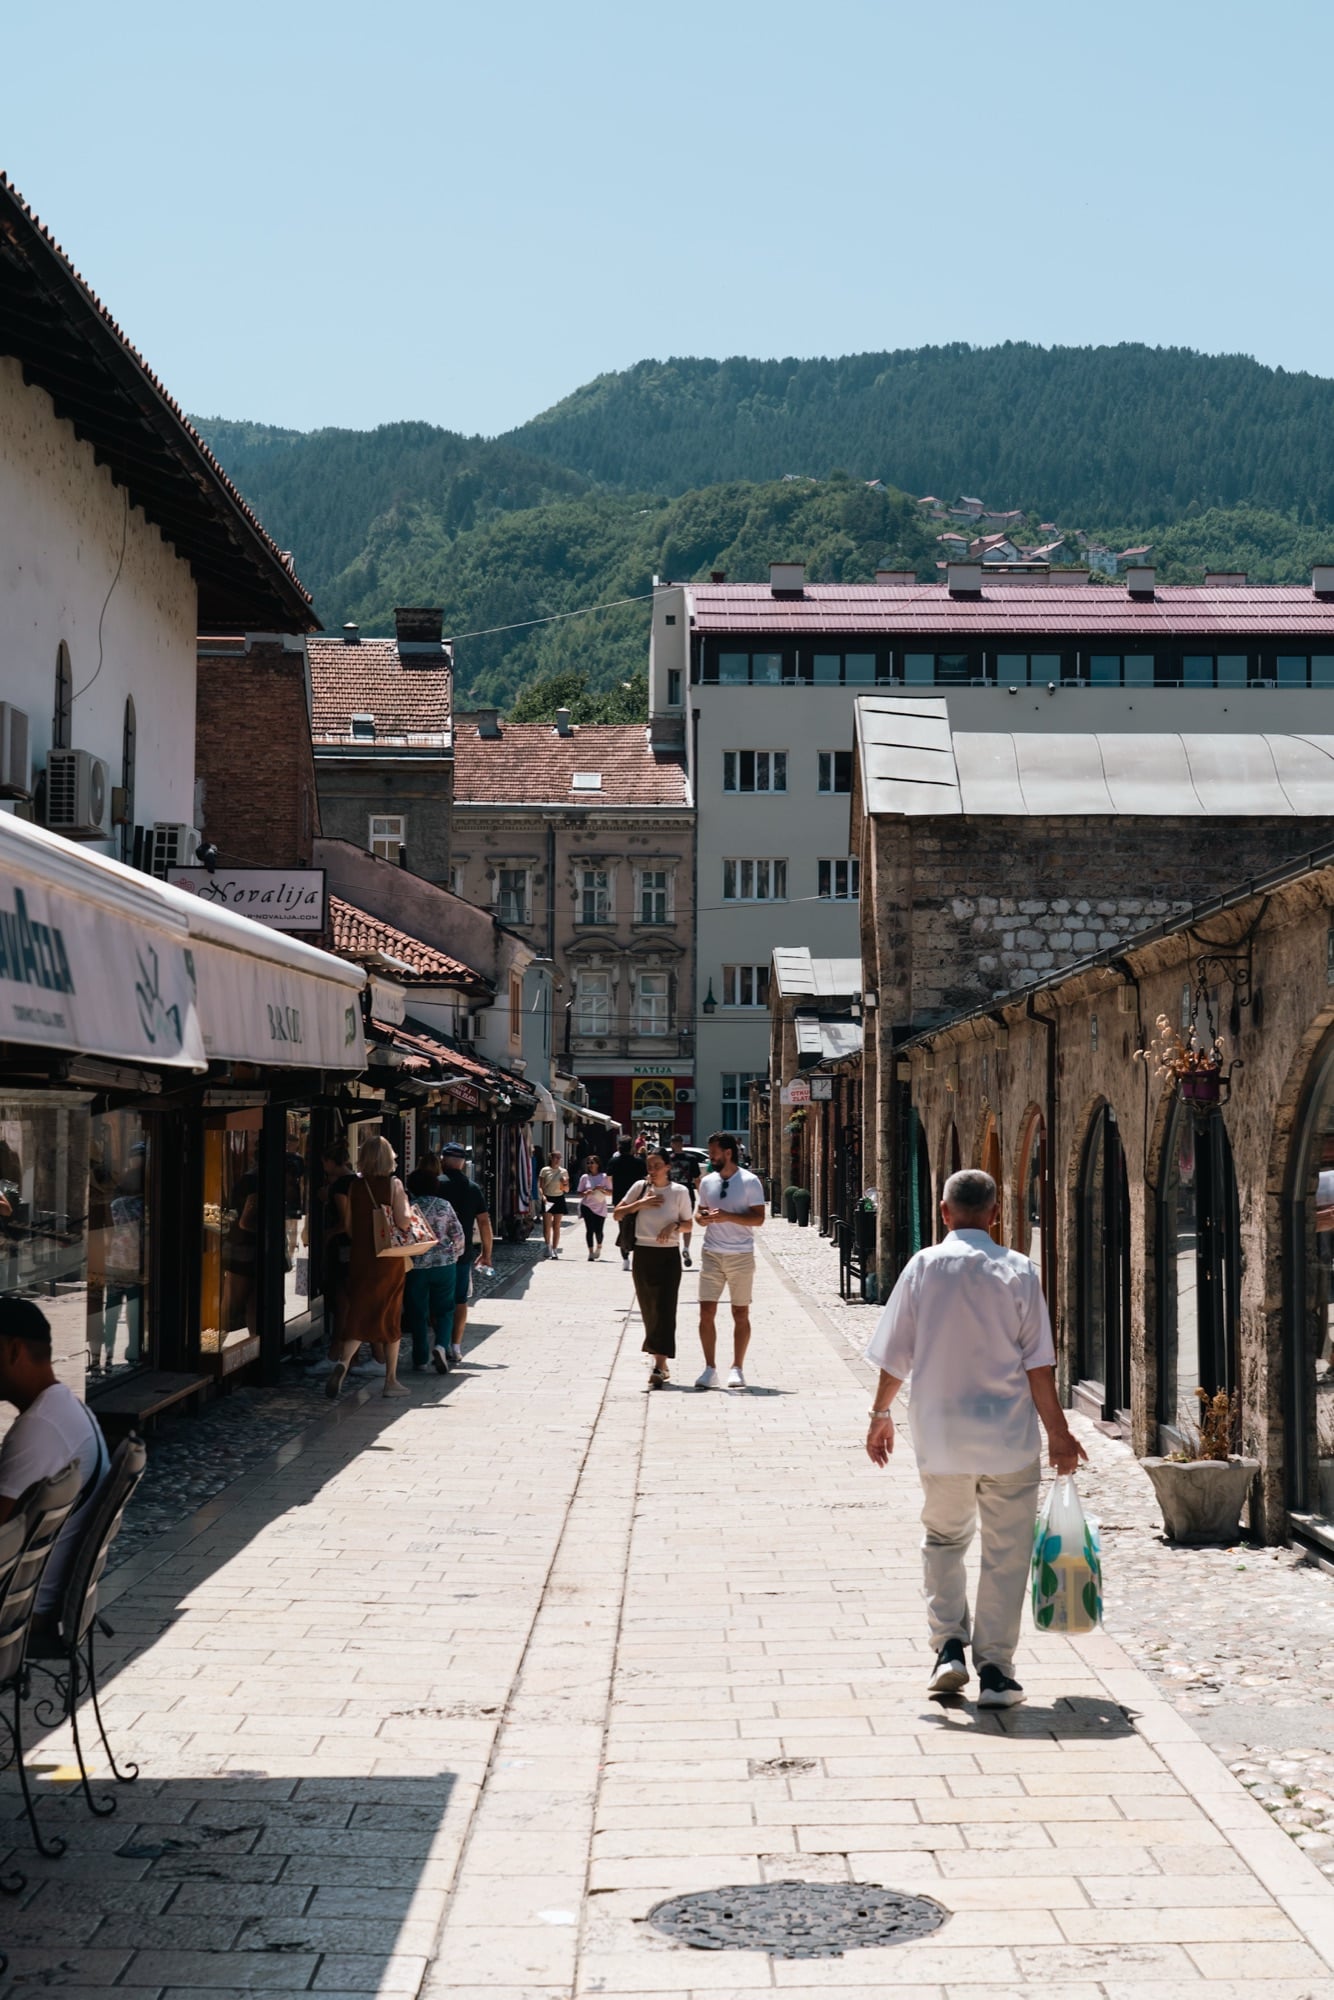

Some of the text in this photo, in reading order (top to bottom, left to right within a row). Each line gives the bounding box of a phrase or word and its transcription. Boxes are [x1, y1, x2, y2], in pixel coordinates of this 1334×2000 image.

[198, 879, 320, 911] Novalija
[633, 1066, 673, 1074] MATIJA
[790, 1089, 809, 1097] OTKU
